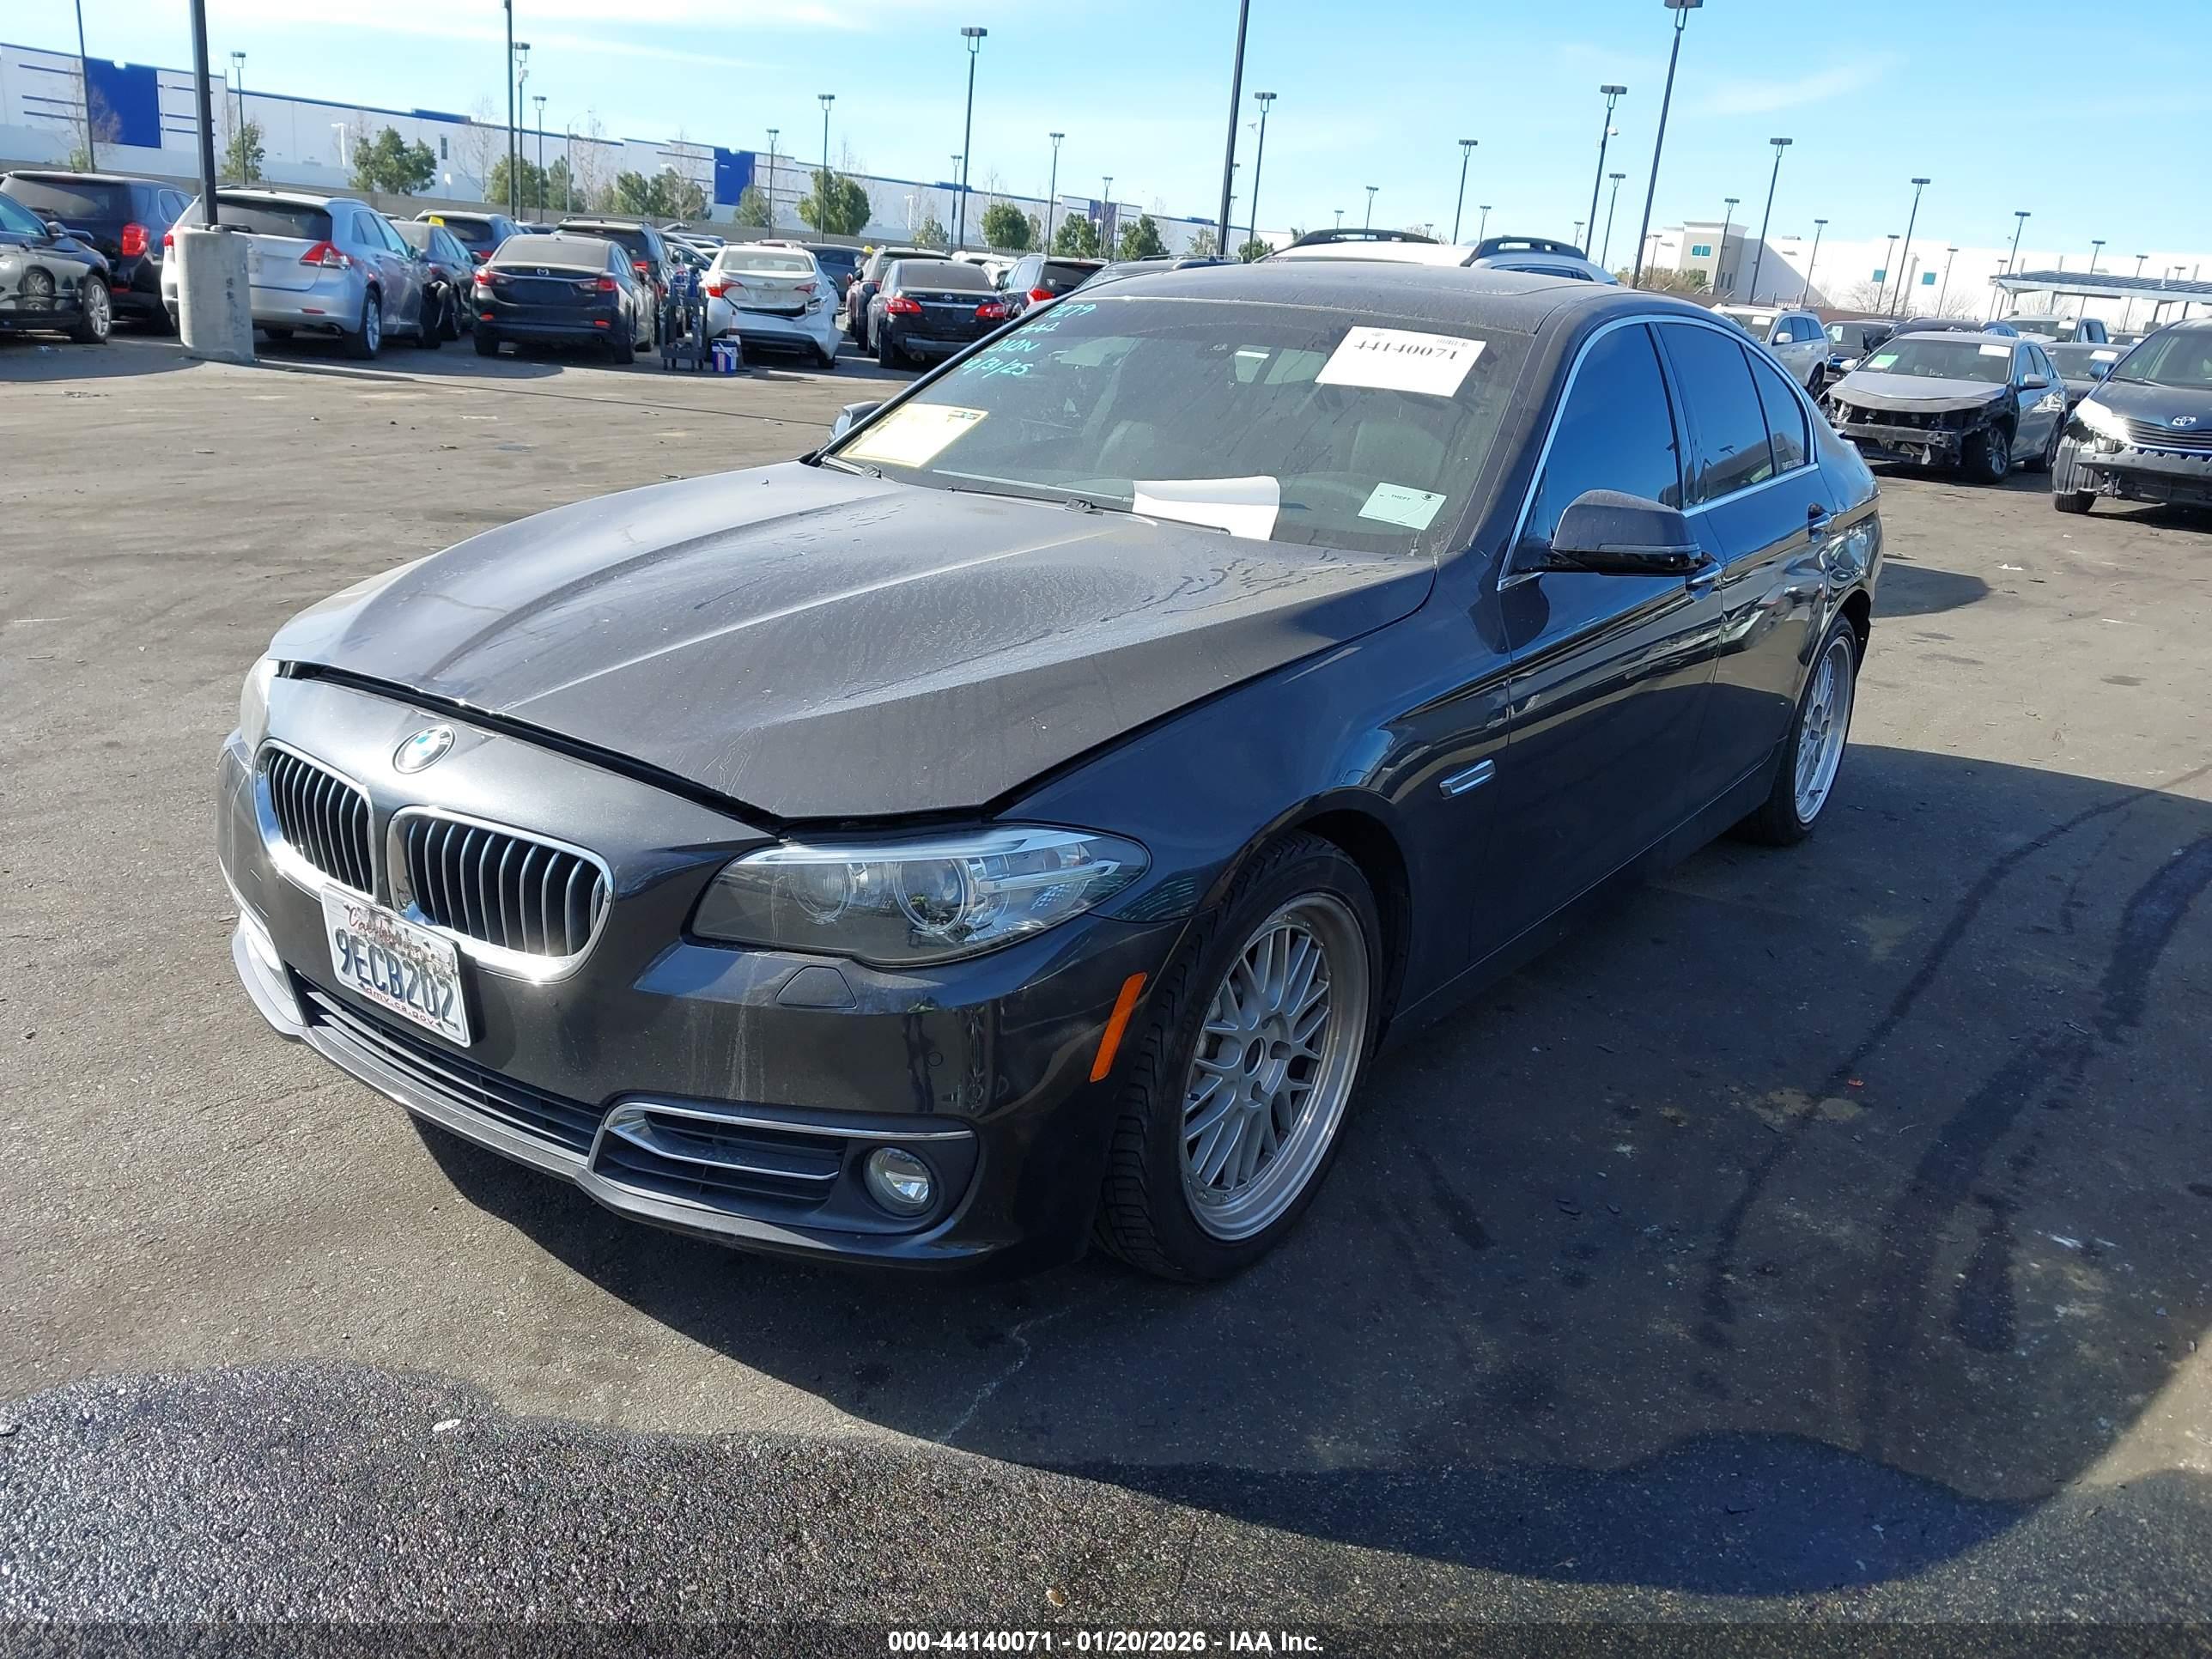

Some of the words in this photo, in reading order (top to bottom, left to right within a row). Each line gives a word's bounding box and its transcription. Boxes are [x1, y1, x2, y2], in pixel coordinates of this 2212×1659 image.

[1354, 340, 1458, 360] 44140071
[959, 356, 1035, 379] 12/31/25
[335, 927, 461, 1032] 9ECB202
[366, 988, 435, 1026] dmv.ca.gov
